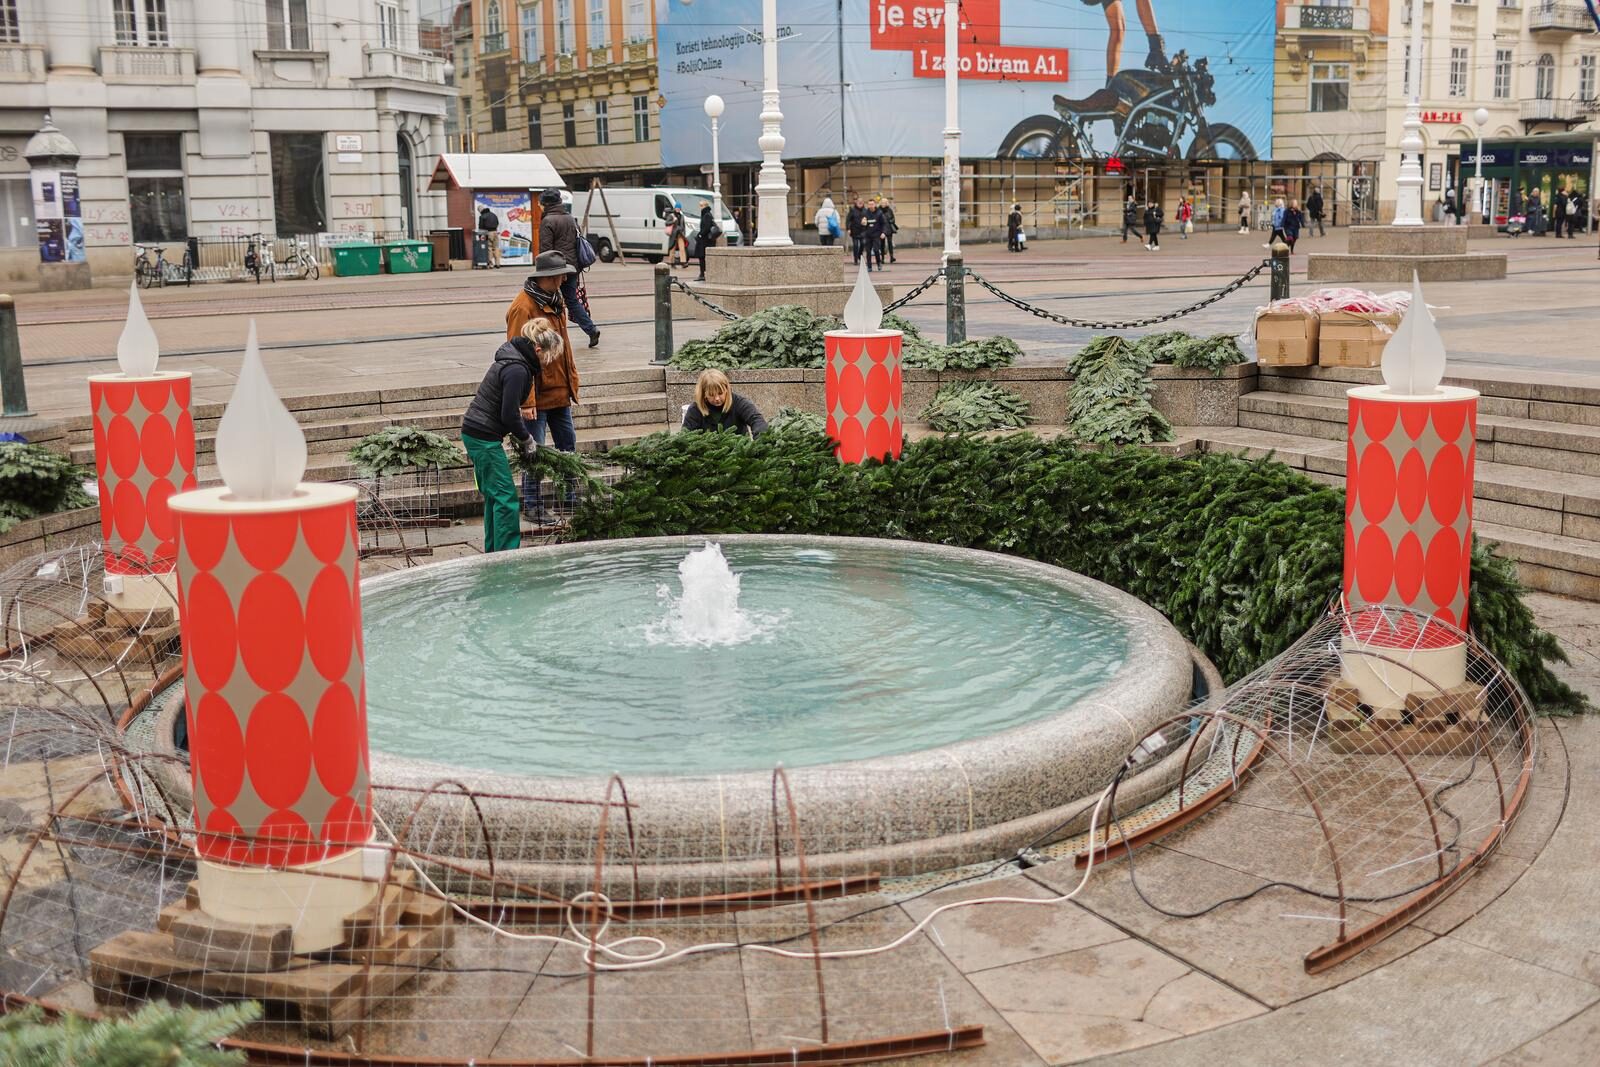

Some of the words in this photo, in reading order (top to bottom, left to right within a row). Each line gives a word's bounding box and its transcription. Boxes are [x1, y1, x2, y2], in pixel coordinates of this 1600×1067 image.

[878, 0, 904, 33] je
[912, 7, 967, 30] sv.
[676, 41, 700, 55] Koristi
[701, 33, 745, 50] tehnologiju
[746, 26, 794, 45] odgrno.
[677, 57, 722, 74] #BoljiOnline
[920, 49, 928, 70] I
[932, 56, 972, 72] zo
[976, 52, 1030, 74] biram
[1034, 55, 1063, 75] A1.
[1419, 111, 1463, 123] AN-PEK
[217, 205, 251, 218] V2K
